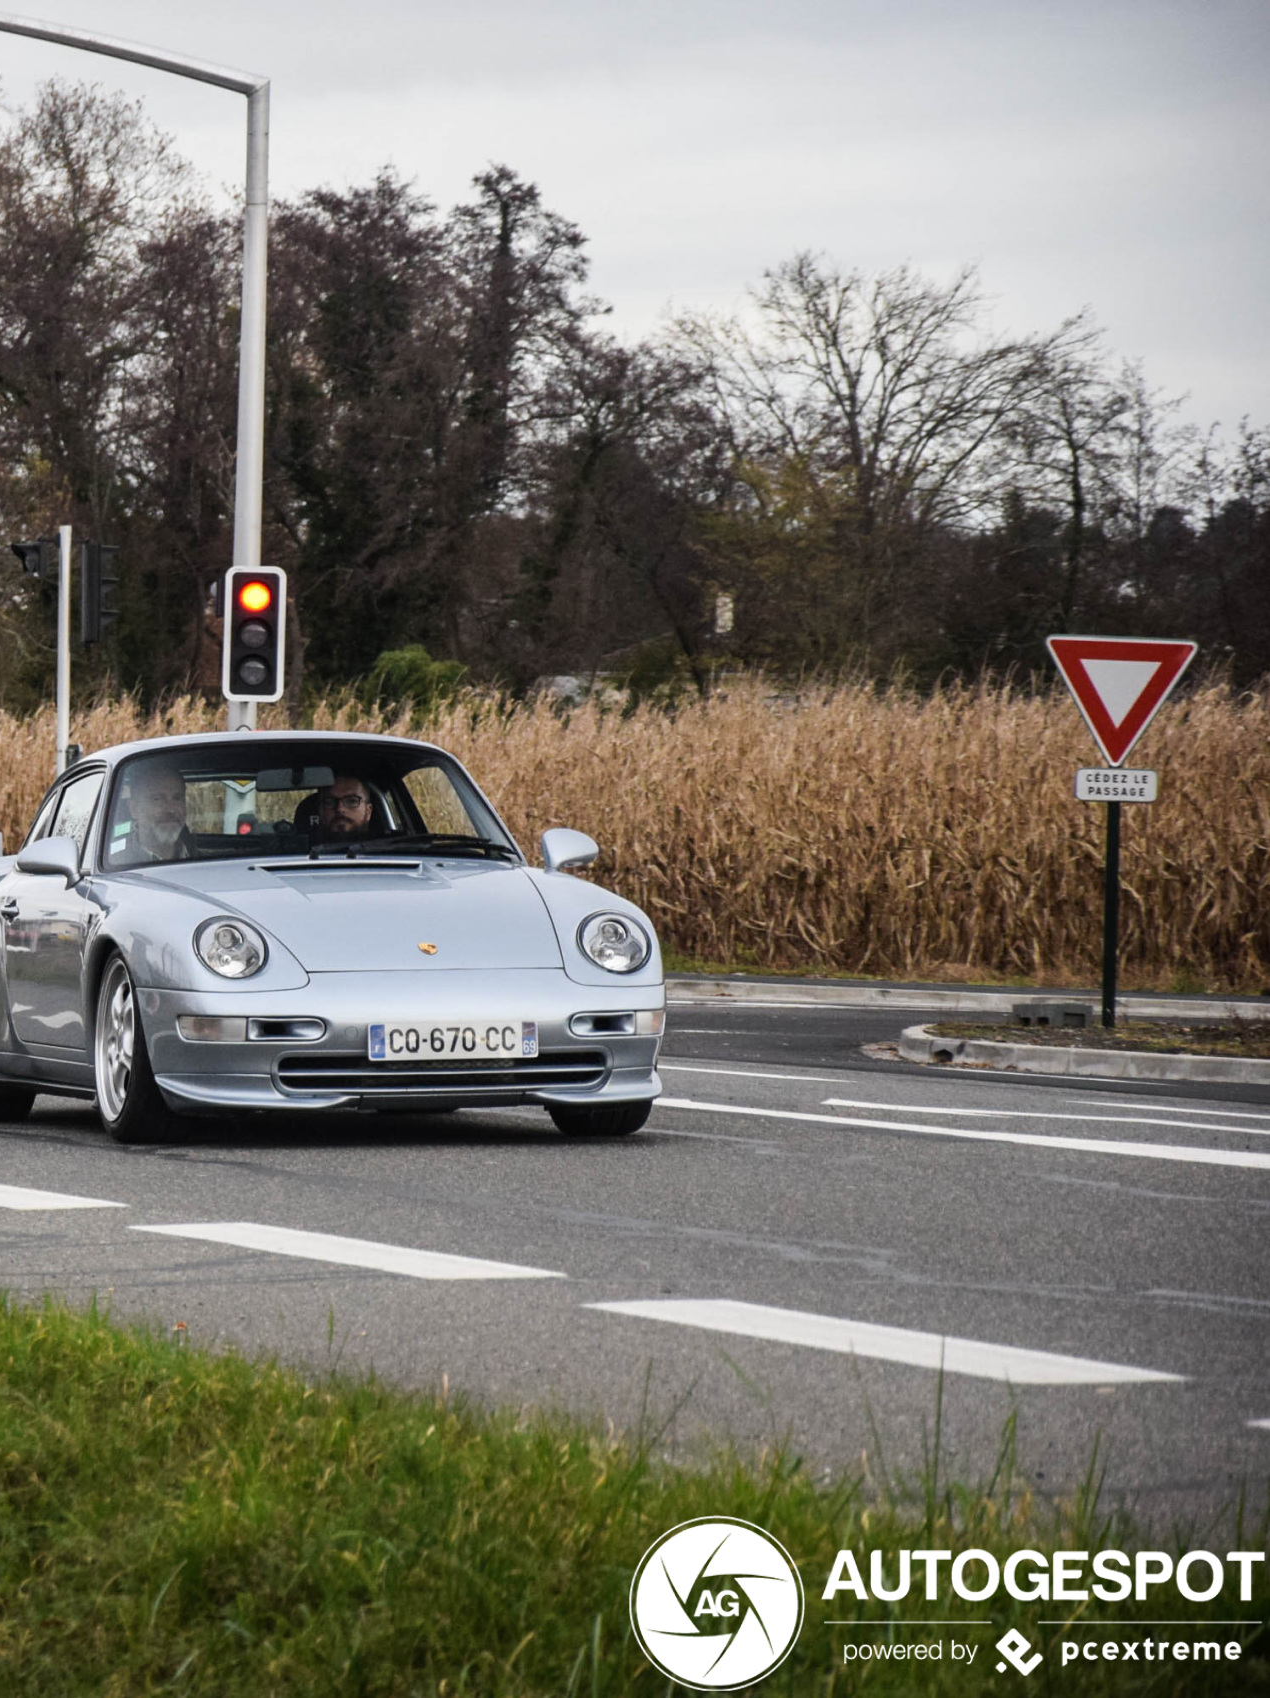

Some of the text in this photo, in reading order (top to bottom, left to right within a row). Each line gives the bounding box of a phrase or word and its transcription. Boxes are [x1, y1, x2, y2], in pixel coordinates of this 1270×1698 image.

[1086, 773, 1149, 784] CÉDEZ LE
[1088, 786, 1146, 797] PASSAGE
[389, 1025, 516, 1054] CQ-670-CC
[523, 1040, 536, 1054] 69
